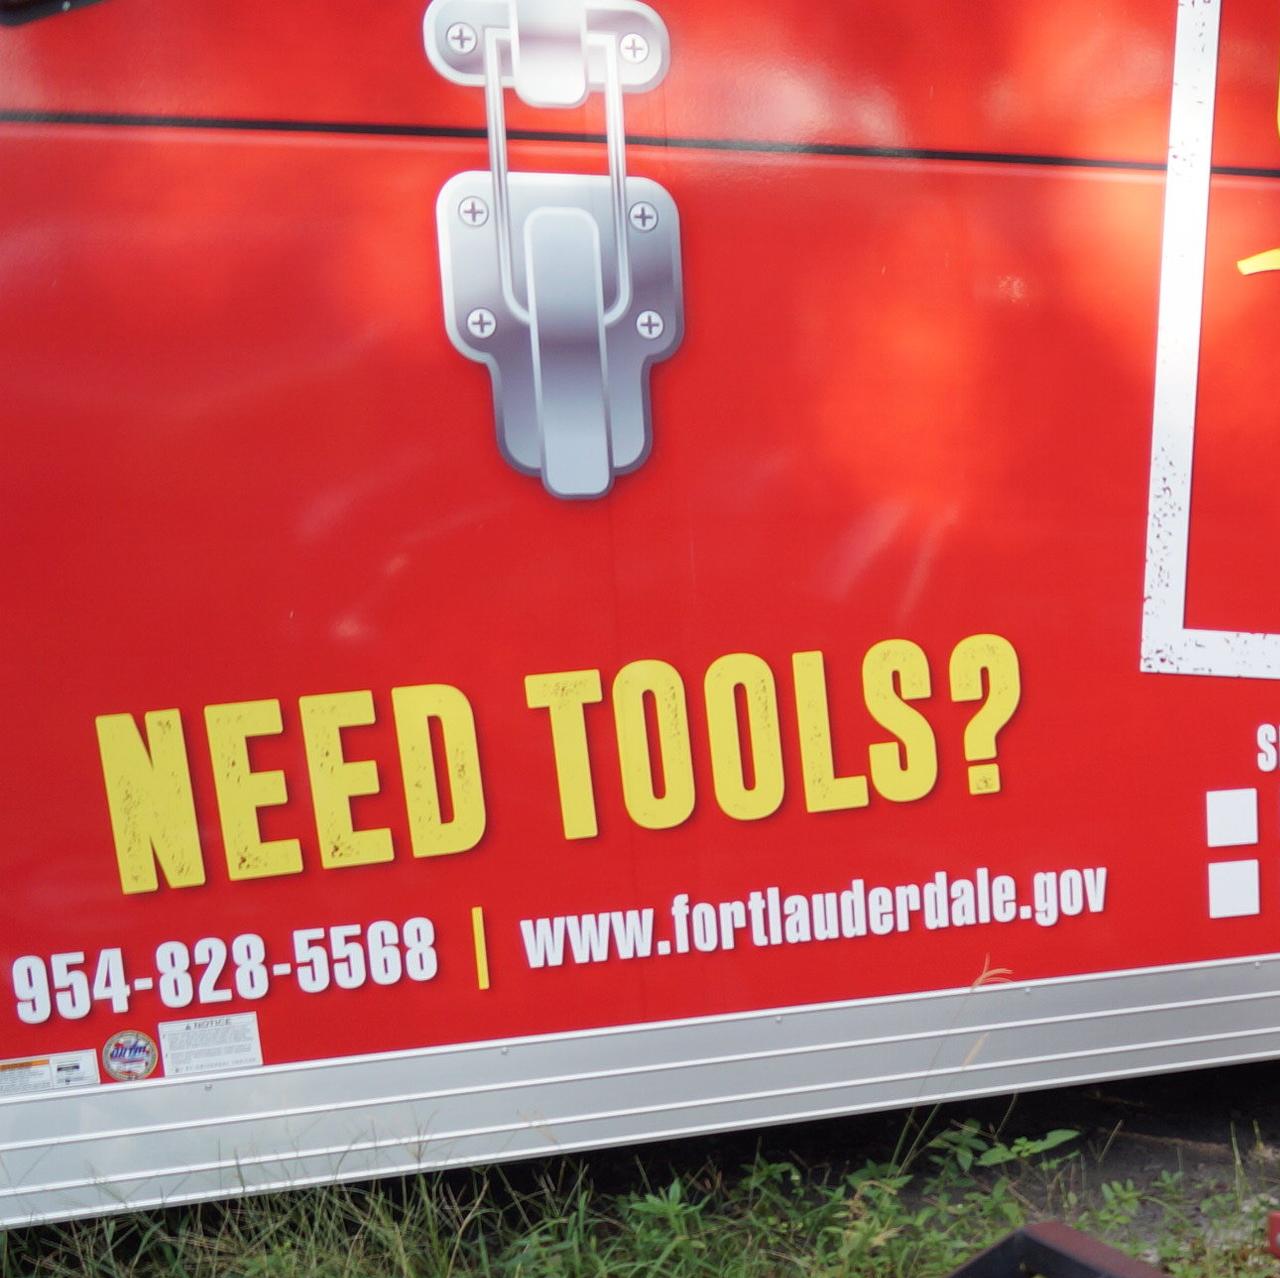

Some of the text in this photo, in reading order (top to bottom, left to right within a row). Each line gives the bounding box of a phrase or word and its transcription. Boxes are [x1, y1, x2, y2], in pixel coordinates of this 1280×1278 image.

[95, 633, 1021, 894] NEED TOOLS?
[12, 866, 1108, 1024] 954-828-5568 www.fortlauderdale.gov
